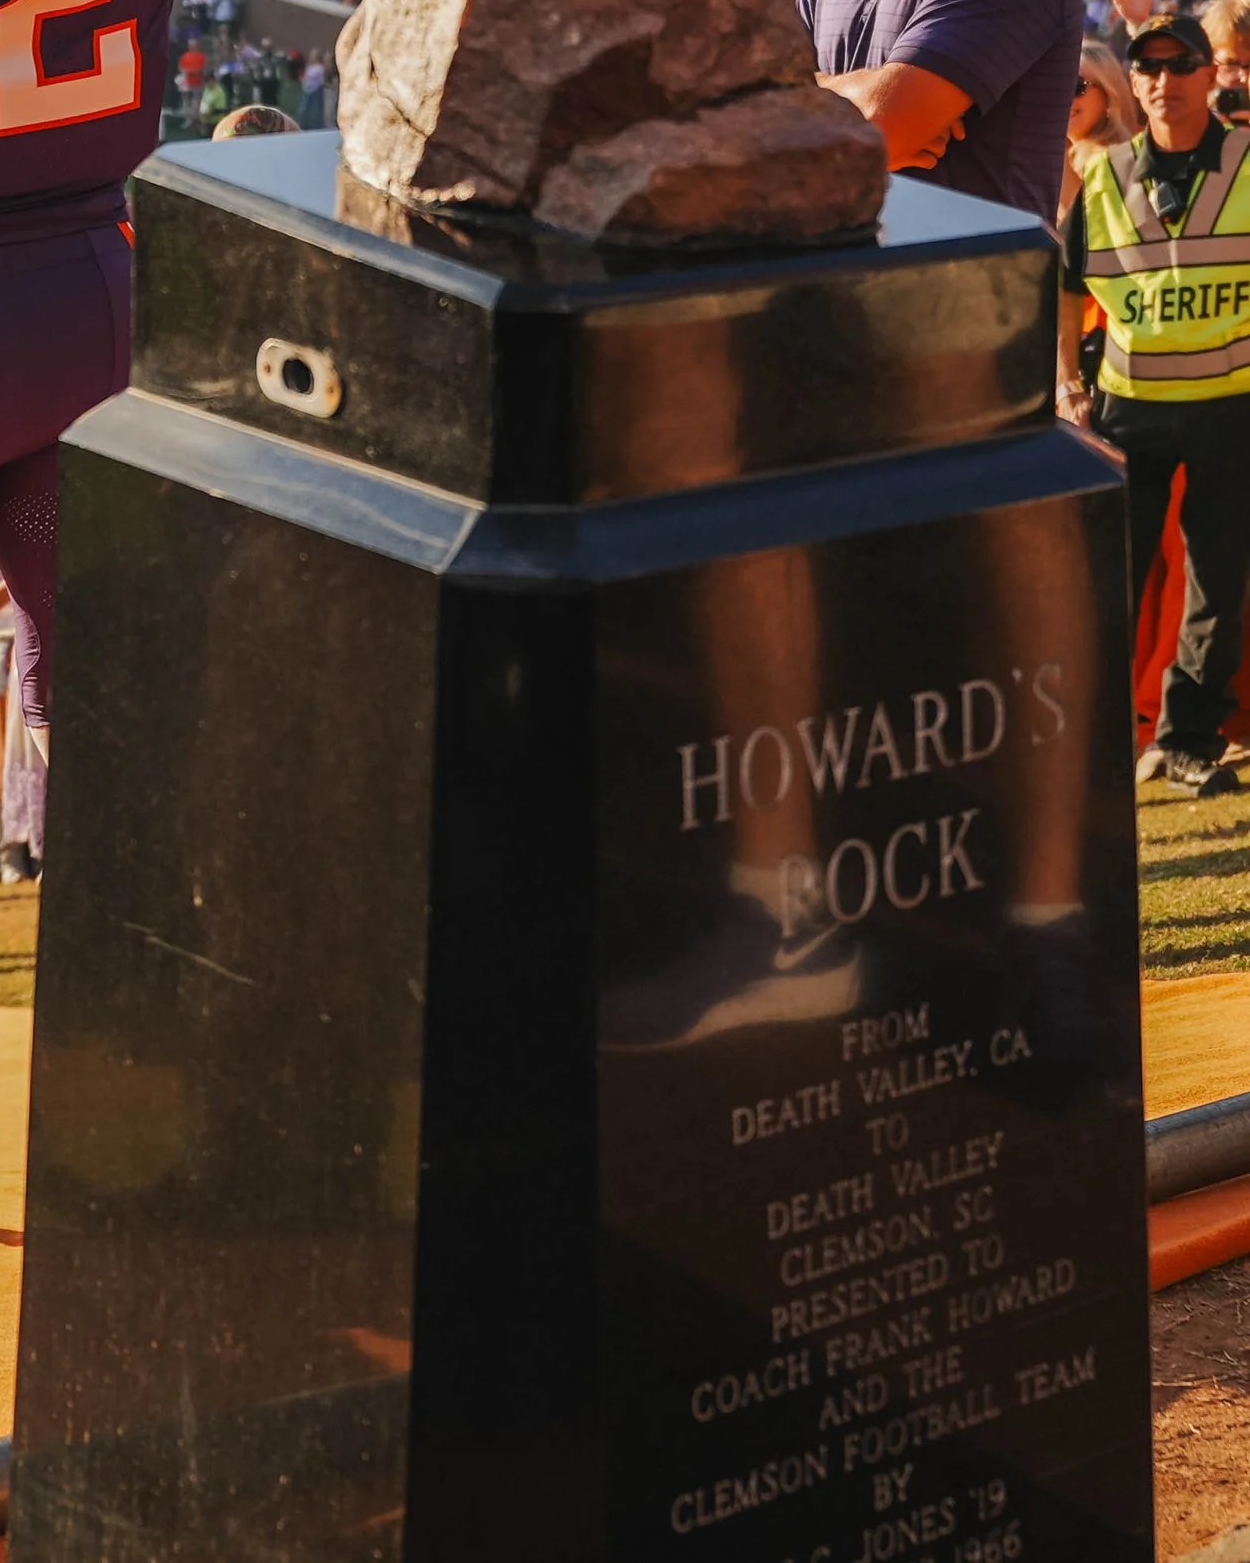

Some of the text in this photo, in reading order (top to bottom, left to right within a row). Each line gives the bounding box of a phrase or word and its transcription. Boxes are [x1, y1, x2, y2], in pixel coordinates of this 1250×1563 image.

[1120, 280, 1250, 325] SHERIFF
[677, 664, 1066, 831] HOWARD'S
[778, 808, 984, 938] ROCK
[841, 1001, 931, 1062] FROM
[732, 1079, 841, 1147] DEATH
[990, 1025, 1033, 1066] CA
[864, 1111, 910, 1156] TO
[766, 1131, 1004, 1240] DEATH VALLEY
[953, 1184, 994, 1231] SC
[771, 1232, 1006, 1342] PRESENTED TO
[690, 1258, 1077, 1423] COACH FRANK HOWARD
[819, 1346, 964, 1431] AND THE
[670, 1345, 1097, 1534] CLEMSON FOOTBALL TEAM
[873, 1462, 913, 1511] BY
[853, 1495, 956, 1563] JONES
